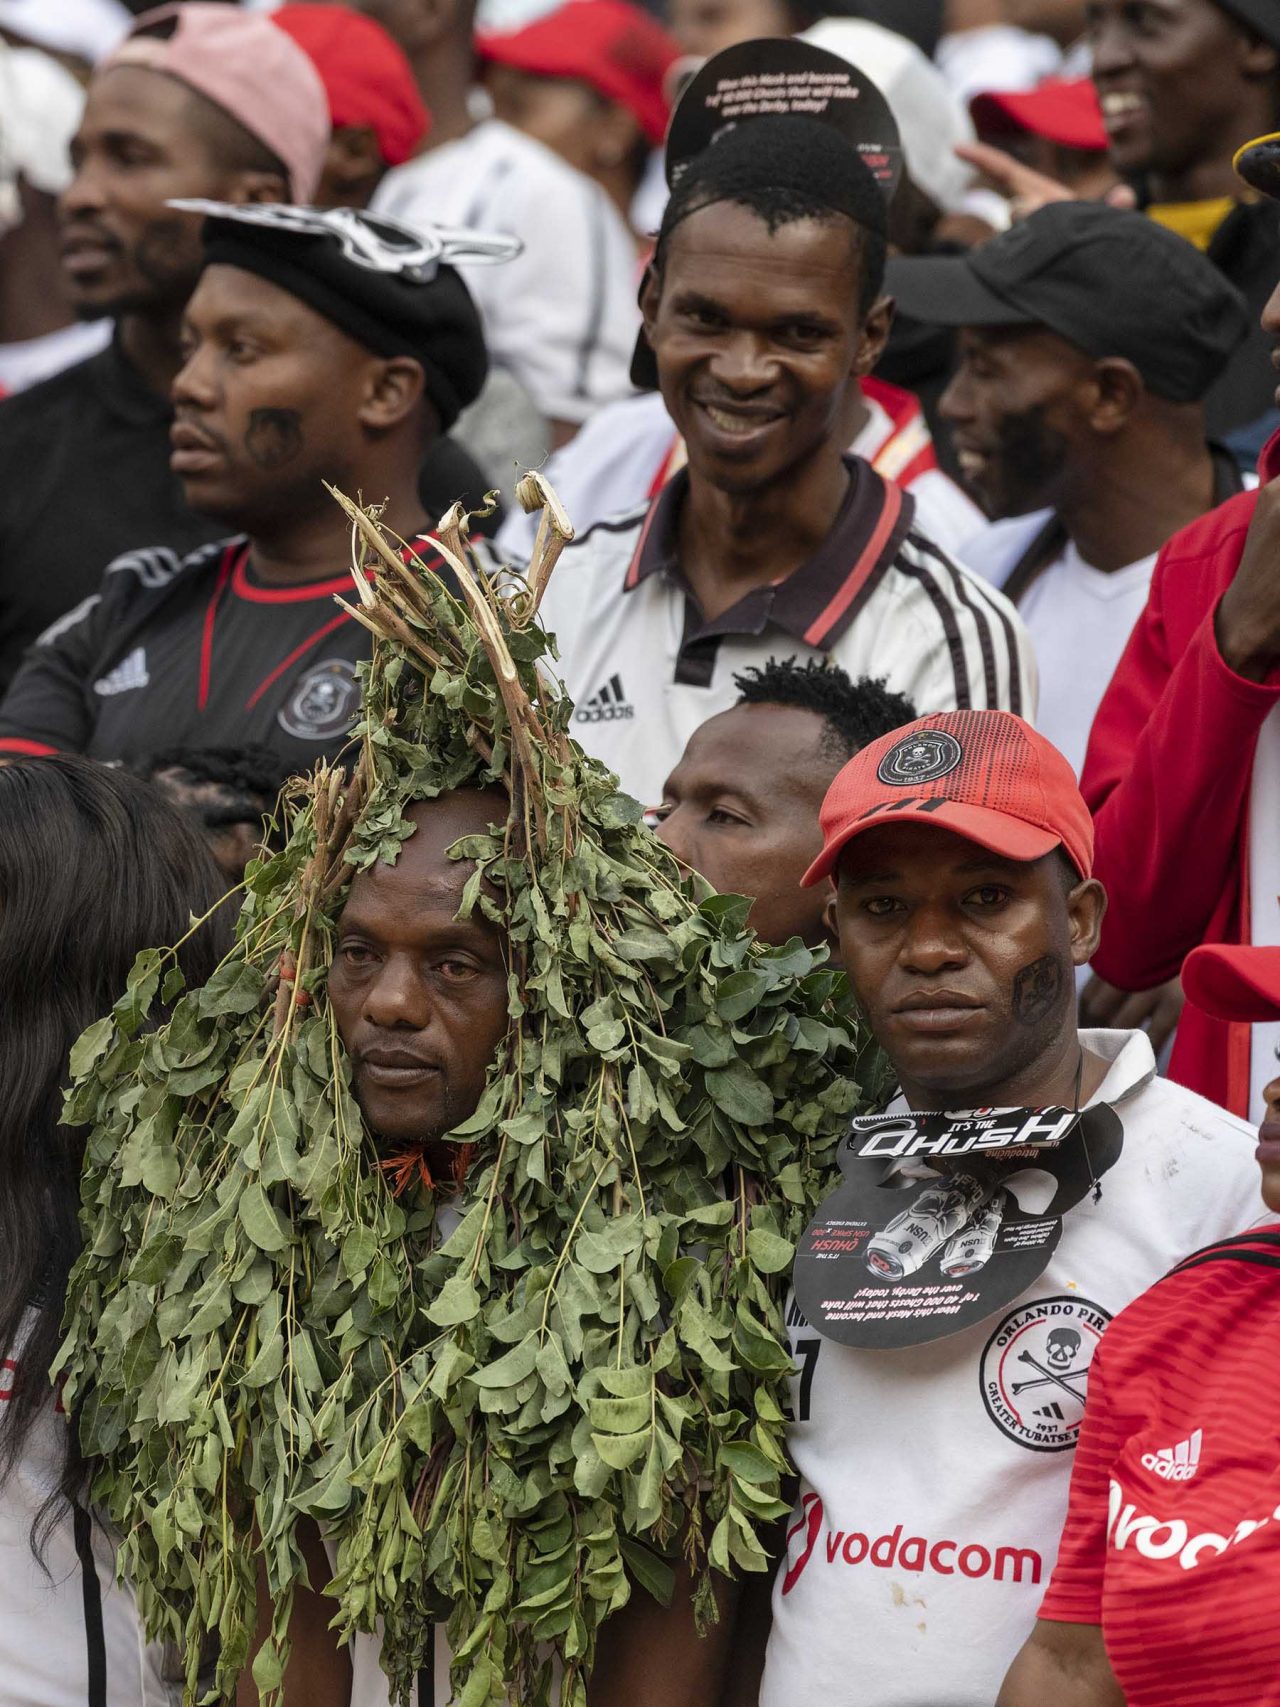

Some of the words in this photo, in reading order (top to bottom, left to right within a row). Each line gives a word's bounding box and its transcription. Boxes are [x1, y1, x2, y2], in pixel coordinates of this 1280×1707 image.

[948, 1120, 973, 1133] IT'S
[975, 1118, 997, 1131] THE
[906, 1223, 929, 1243] USN
[960, 1239, 981, 1249] USN
[854, 1287, 890, 1299] today!
[892, 1287, 923, 1299] Derby,
[924, 1286, 941, 1296] the
[942, 1284, 963, 1293] over
[821, 1300, 846, 1311] take
[845, 1300, 864, 1311] will
[867, 1300, 890, 1311] that
[890, 1298, 925, 1309] Ghosts
[945, 1295, 959, 1306] 40
[886, 1309, 914, 1321] Mask
[914, 1307, 934, 1318] this
[934, 1304, 961, 1315] Wear
[824, 1311, 864, 1322] become
[863, 1310, 886, 1321] and
[996, 1304, 1074, 1348] ORLANDO
[988, 1381, 1018, 1431] GREATER
[1019, 1425, 1073, 1444] TUBATSE
[1036, 1422, 1059, 1433] 1937
[826, 1524, 1043, 1585] vodacom
